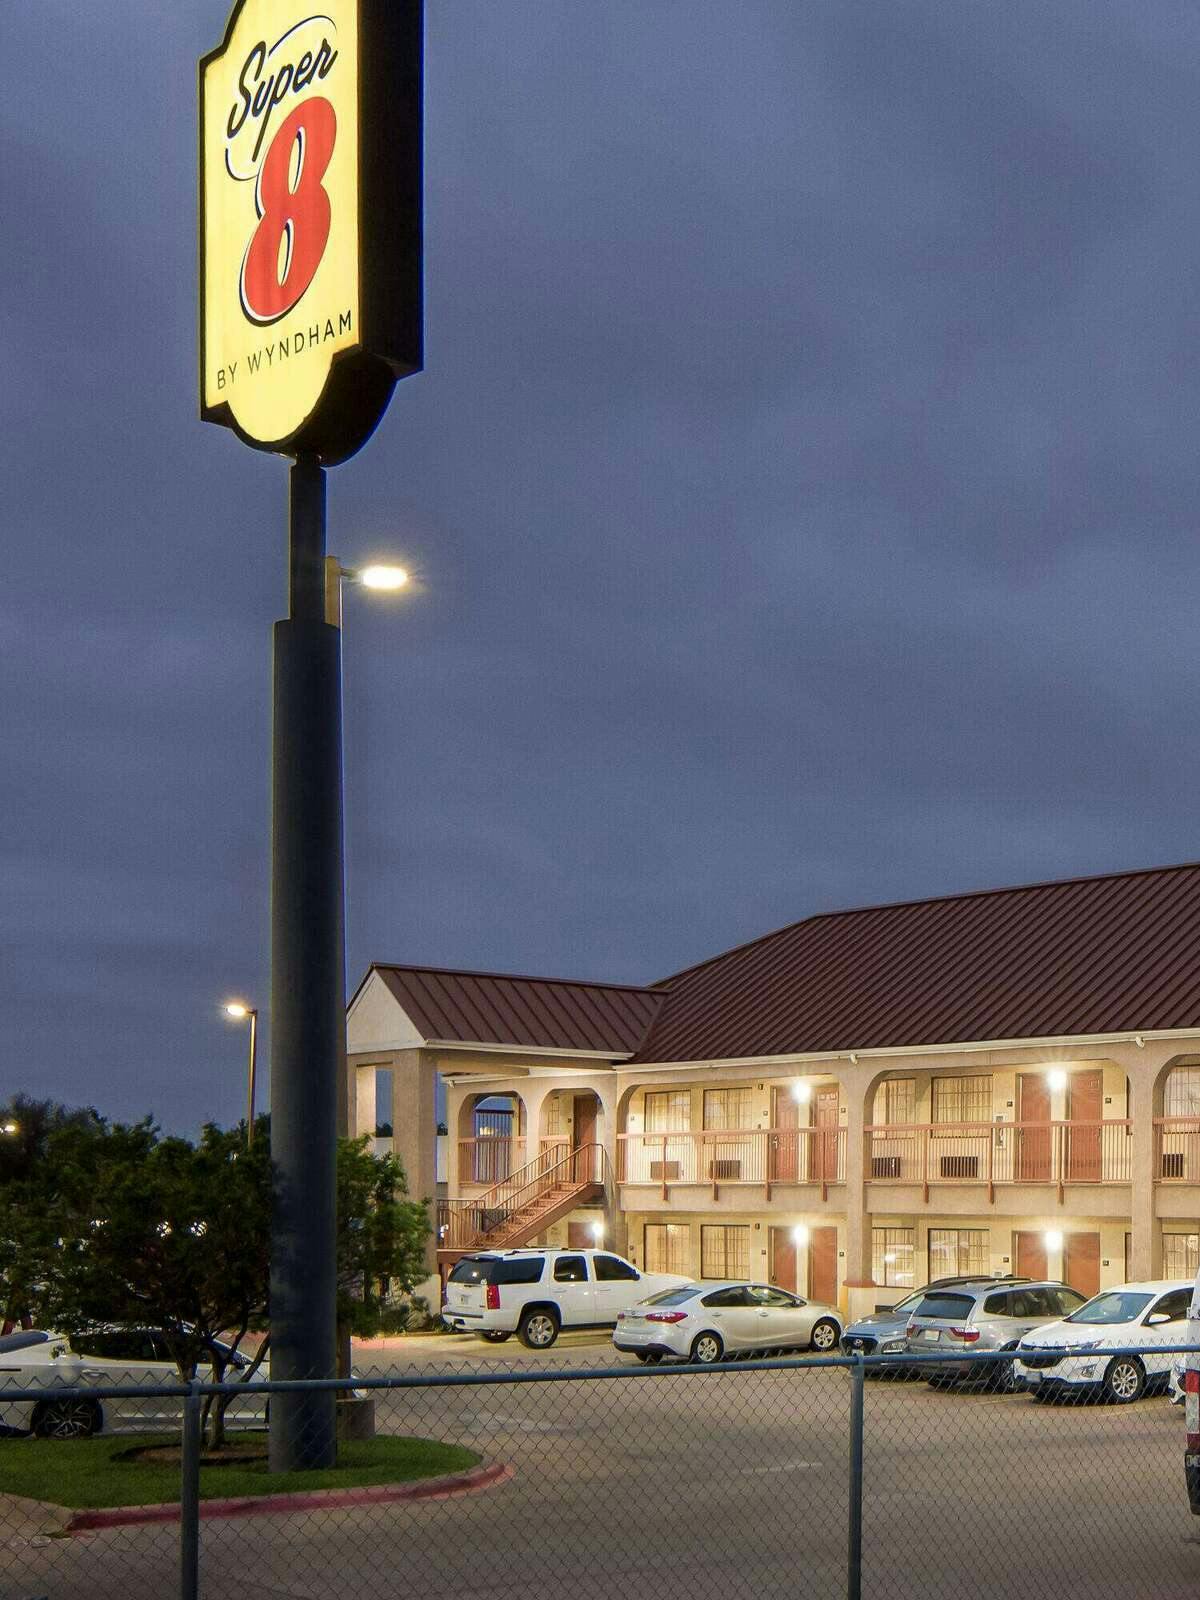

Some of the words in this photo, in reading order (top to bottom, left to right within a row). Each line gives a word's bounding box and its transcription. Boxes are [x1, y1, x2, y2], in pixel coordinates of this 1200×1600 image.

[227, 37, 339, 162] Super
[239, 96, 337, 327] 8
[217, 361, 238, 390] BY
[247, 310, 353, 375] WYNDHAM
